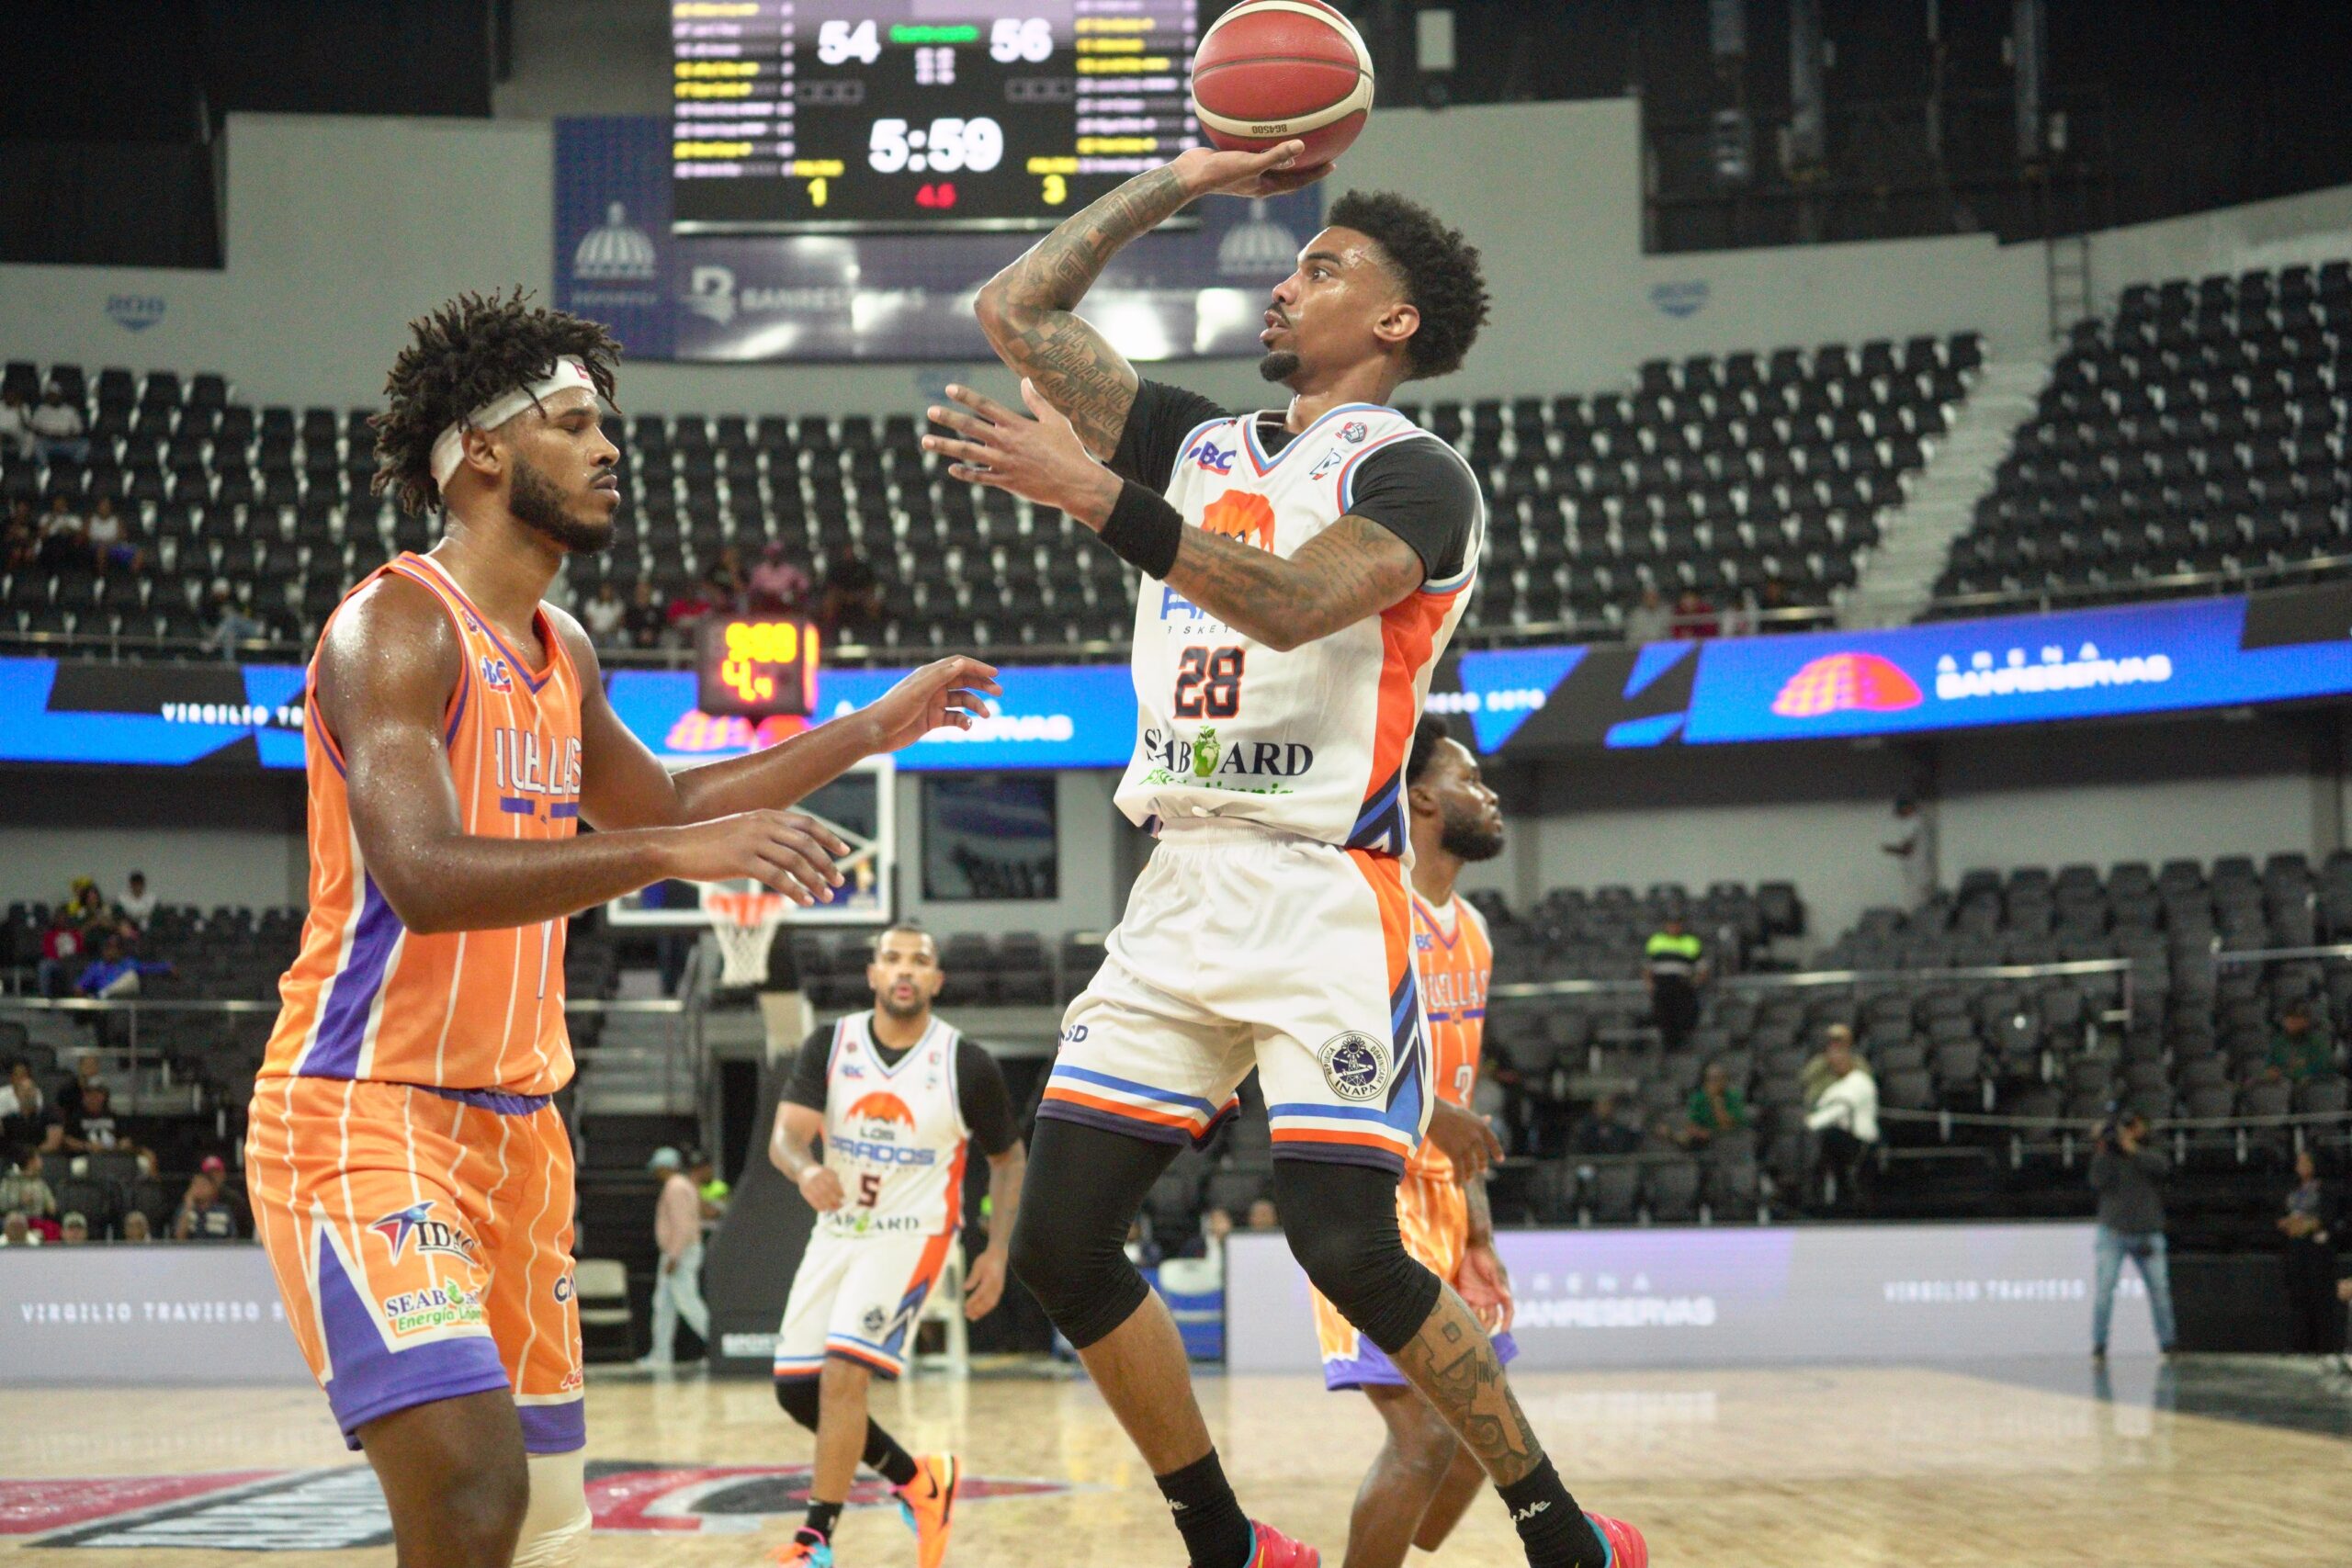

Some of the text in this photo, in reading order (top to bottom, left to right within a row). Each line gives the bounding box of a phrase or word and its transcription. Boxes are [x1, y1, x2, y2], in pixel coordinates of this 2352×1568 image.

[818, 19, 880, 64] 54
[989, 18, 1053, 62] 56
[868, 117, 1002, 173] 5:59
[807, 177, 828, 208] 1
[1042, 175, 1067, 205] 3
[1172, 645, 1246, 720] 28
[1334, 1078, 1378, 1096] INAPA
[859, 1125, 896, 1141] LOS
[857, 1173, 881, 1207] 5
[21, 1303, 132, 1324] VIRGILIO
[142, 1301, 261, 1323] TRAVIESO
